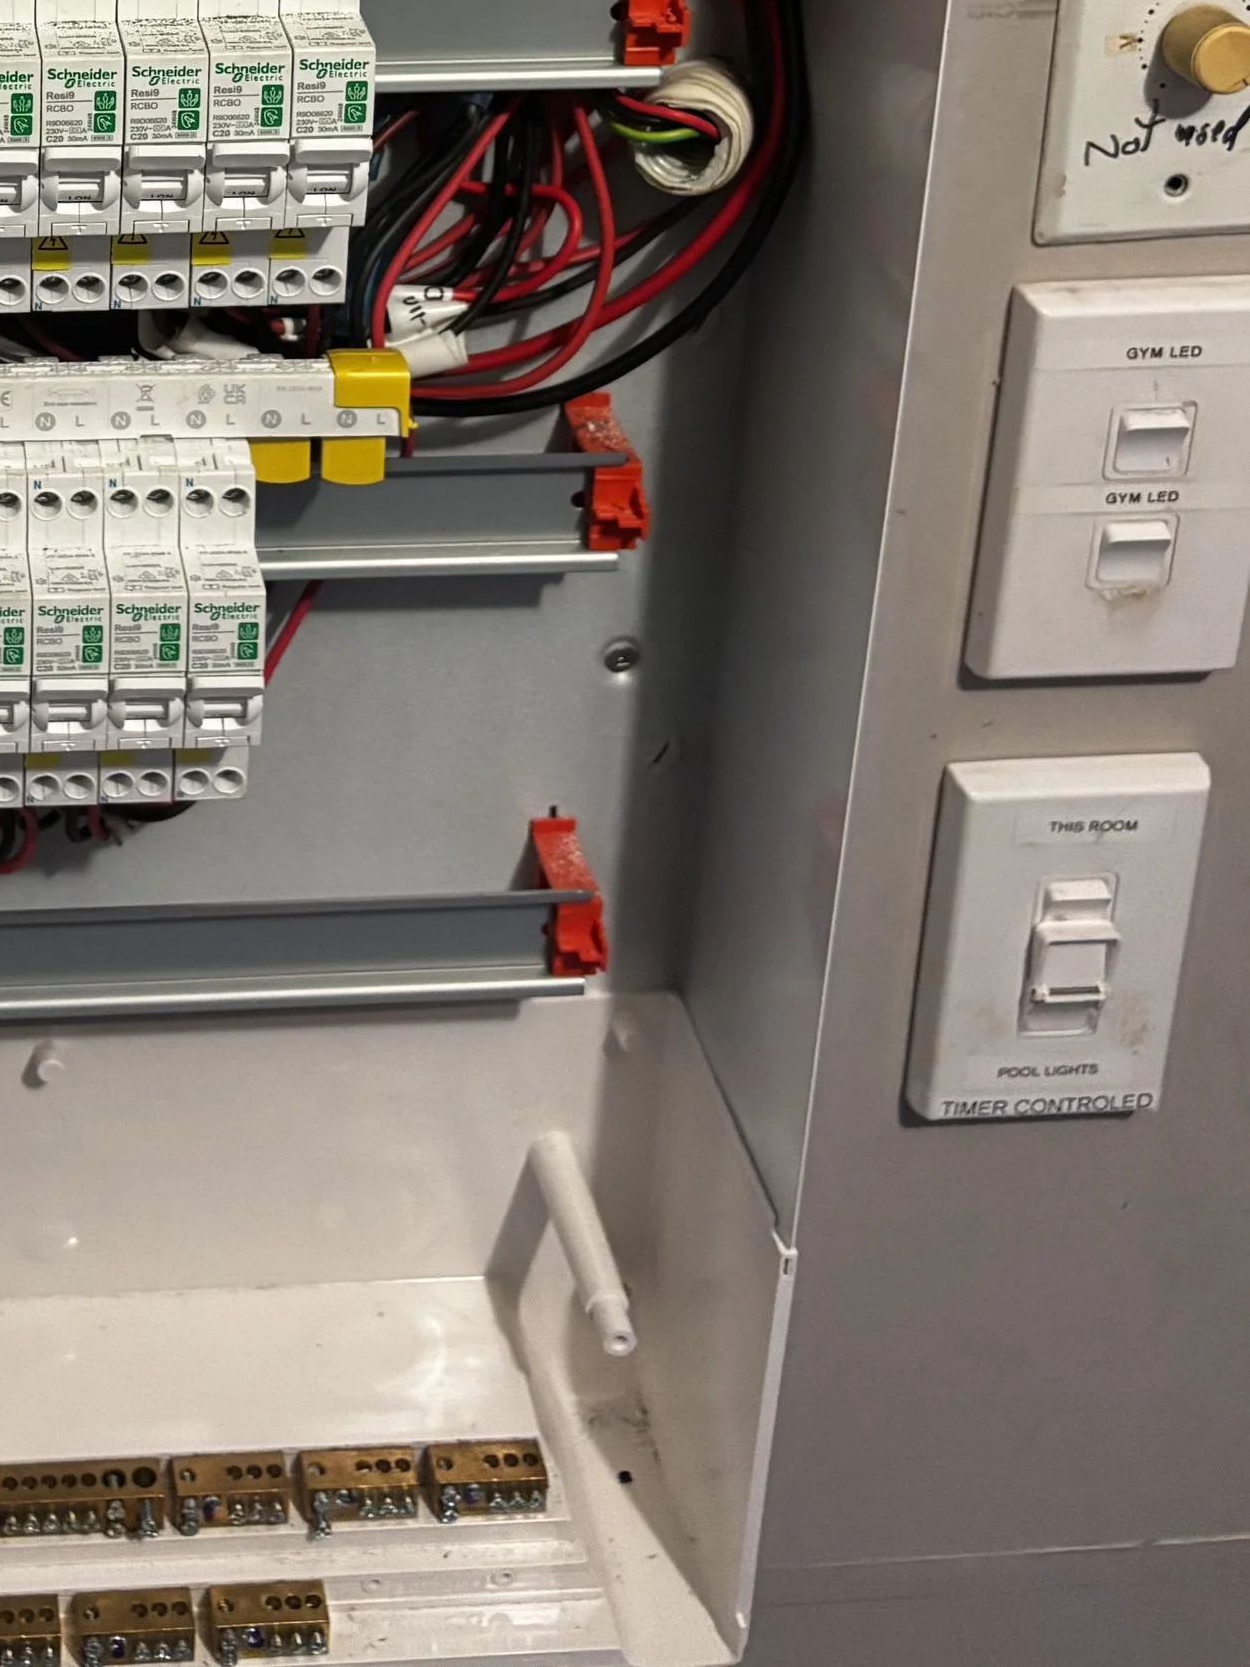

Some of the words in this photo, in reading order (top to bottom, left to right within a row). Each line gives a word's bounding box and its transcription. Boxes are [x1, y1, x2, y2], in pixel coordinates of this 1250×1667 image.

[132, 66, 202, 82] Schneider
[215, 63, 285, 79] Schneider
[299, 59, 369, 75] Schneider
[329, 70, 367, 78] Electric
[47, 68, 117, 84] Schneider
[78, 79, 115, 87] Electric
[162, 77, 199, 85] Electric
[245, 74, 282, 82] Electric
[297, 82, 326, 90] Resi9
[297, 95, 324, 103] RCBO
[1084, 98, 1165, 166] Not
[1126, 346, 1163, 360] GYM
[1170, 346, 1202, 358] LED
[1105, 491, 1141, 505] GYM
[1147, 490, 1179, 504] LED
[37, 606, 103, 620] Schneider
[116, 603, 181, 618] Schneider
[194, 602, 260, 617] Schneider
[1049, 820, 1084, 834] THIS
[1089, 819, 1138, 833] ROOM
[998, 1065, 1040, 1078] POOL
[1045, 1063, 1098, 1077] LIGHTS
[942, 1100, 1008, 1116] TIMER
[1014, 1092, 1154, 1116] CONTROLED
